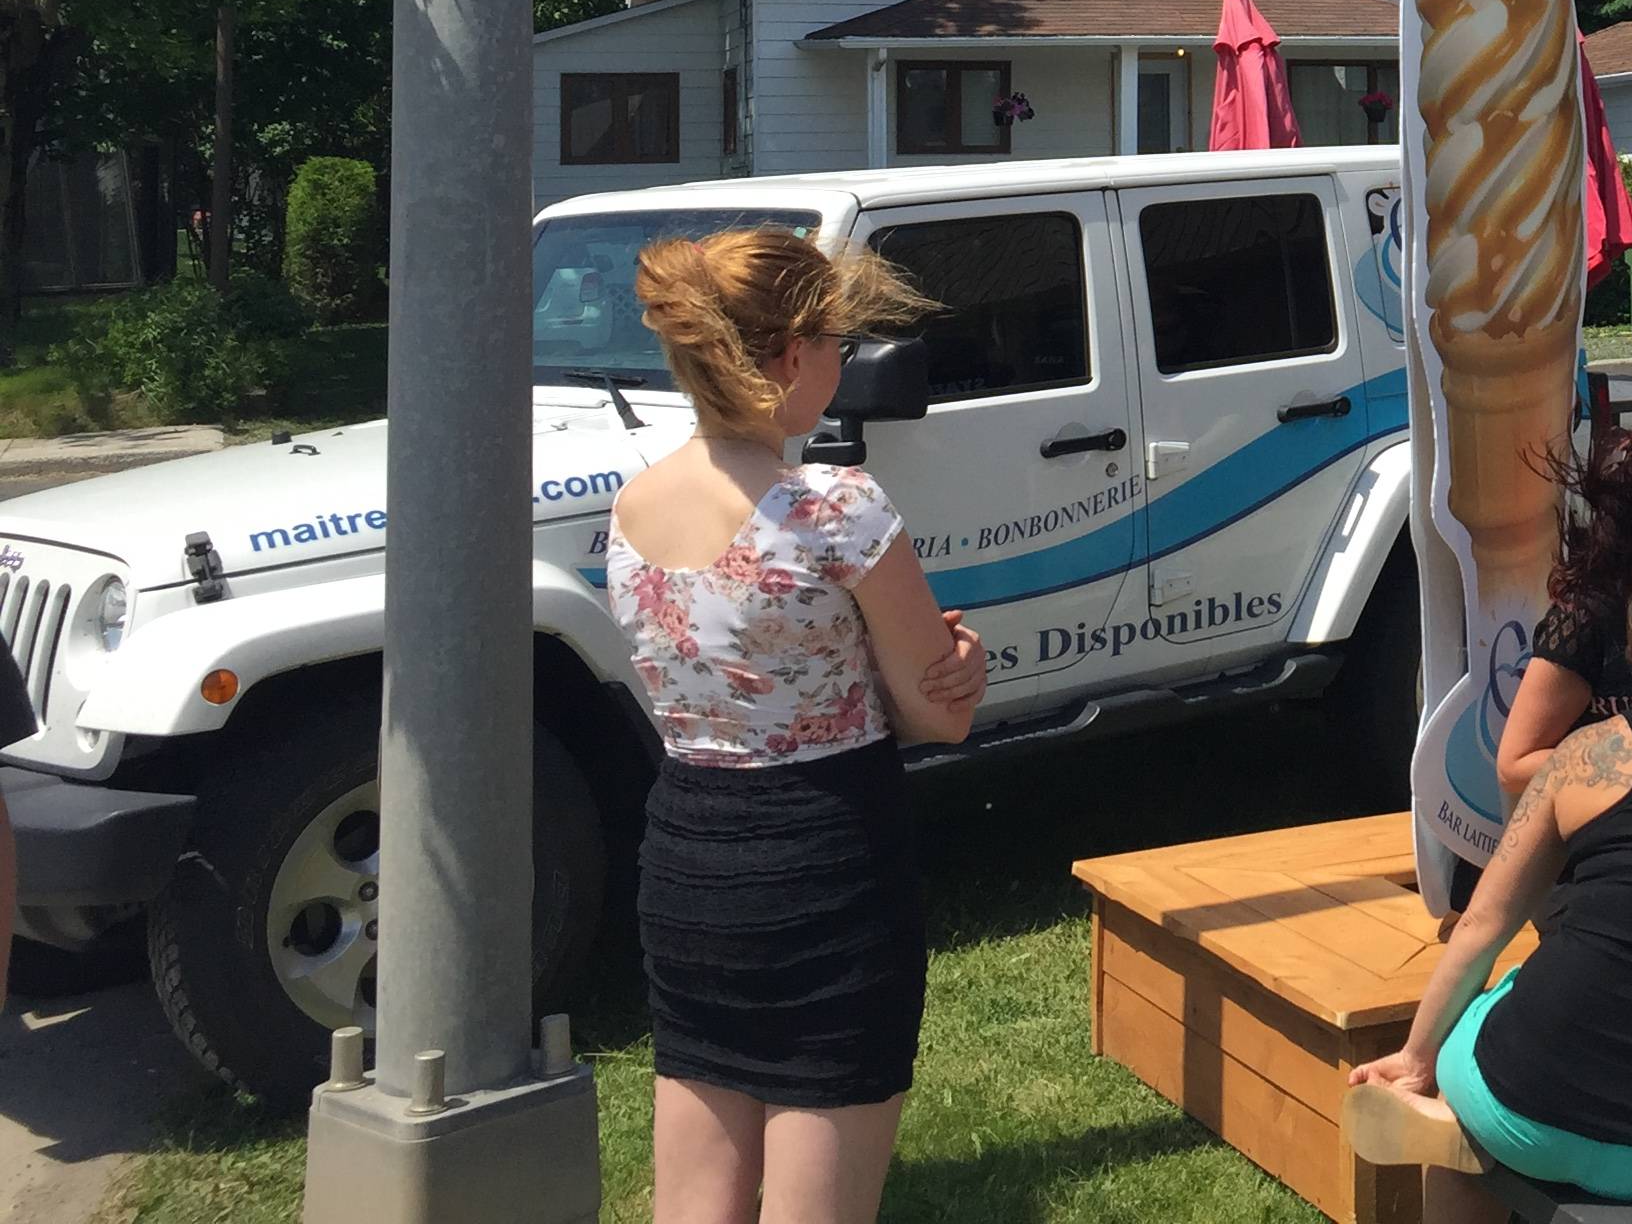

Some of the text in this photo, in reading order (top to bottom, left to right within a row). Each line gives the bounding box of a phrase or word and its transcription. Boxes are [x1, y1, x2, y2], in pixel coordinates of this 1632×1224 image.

[249, 470, 624, 552] maitre .com
[977, 474, 1143, 550] BONBONNERIE
[1035, 592, 1283, 663] Disponibles
[1437, 799, 1462, 836] BAR
